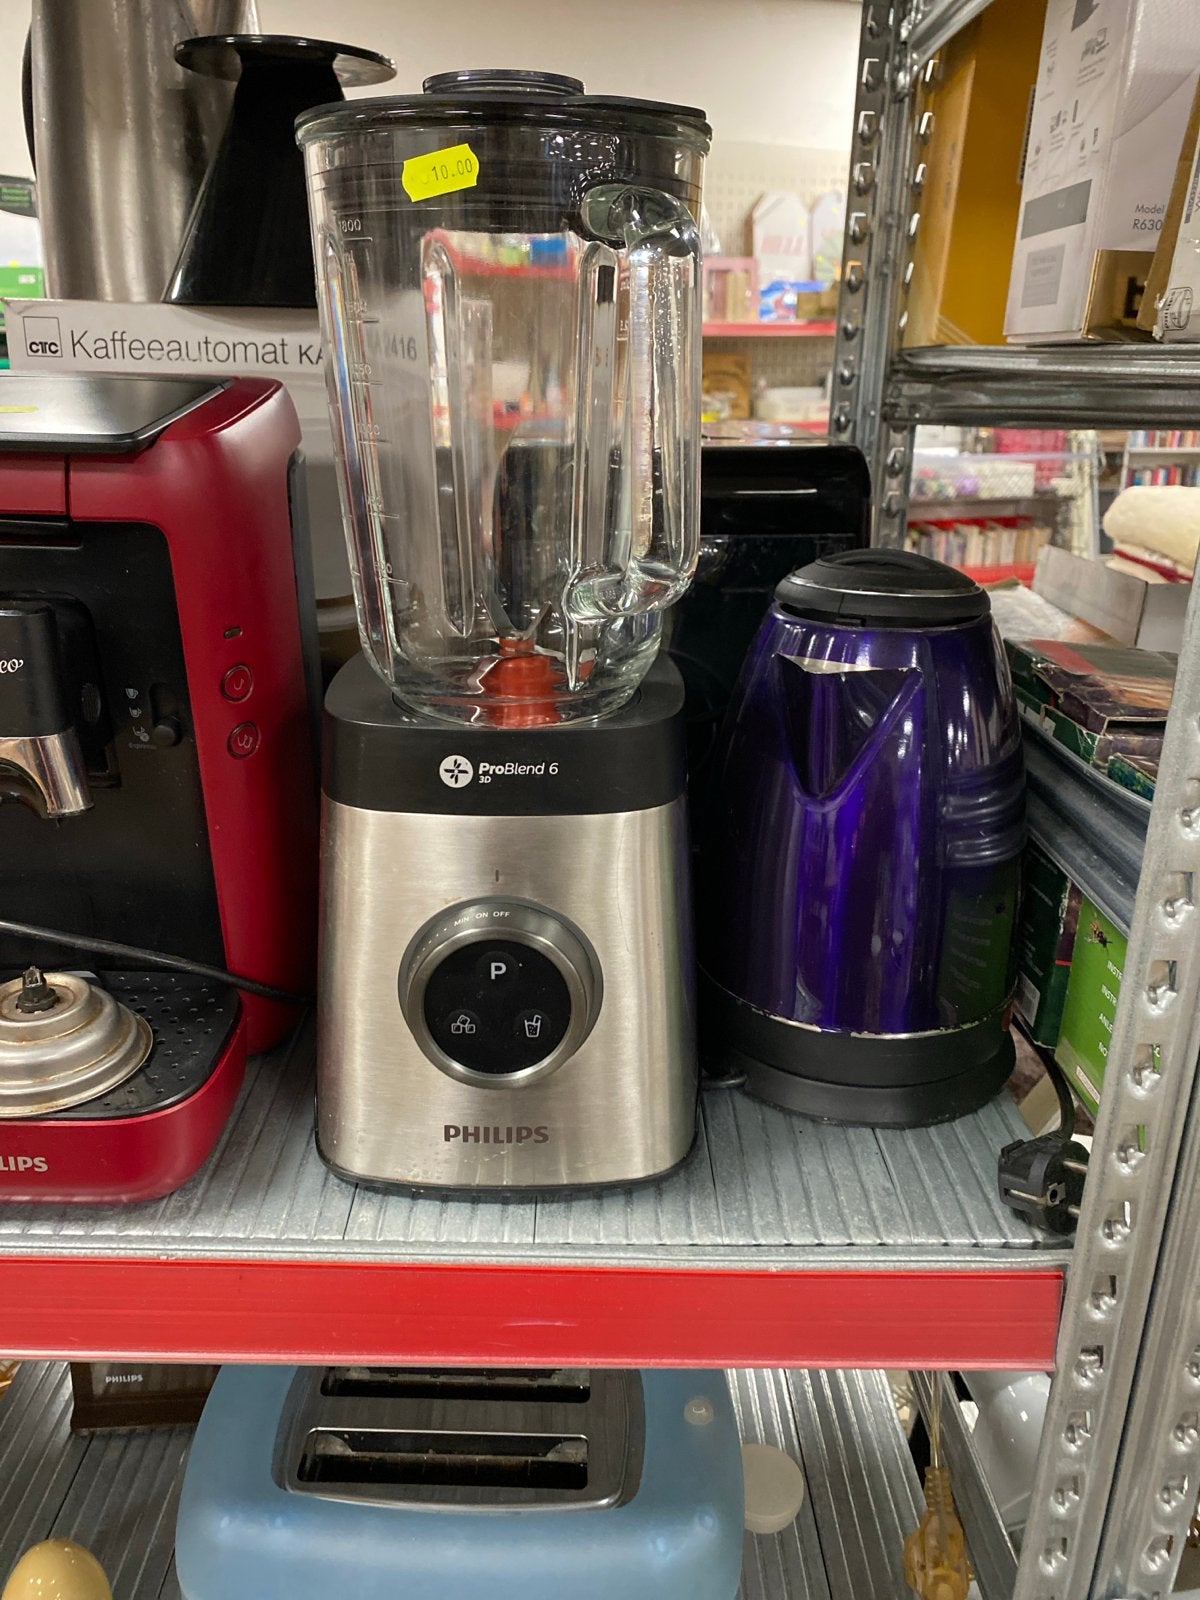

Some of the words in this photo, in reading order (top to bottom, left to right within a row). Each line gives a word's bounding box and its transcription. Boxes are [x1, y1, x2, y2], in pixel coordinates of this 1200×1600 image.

[432, 158, 472, 181] 10.00
[1134, 203, 1165, 214] Model
[70, 329, 290, 366] Kaffeeautomat
[478, 762, 546, 775] ProBlend
[549, 762, 559, 775] 6
[478, 775, 492, 784] 3D
[453, 916, 470, 927] MIN
[475, 911, 489, 919] ON
[490, 962, 507, 980] P
[443, 1124, 550, 1144] PHILIPS
[0, 1155, 49, 1173] LIPS
[105, 1374, 143, 1384] PHILIPS
